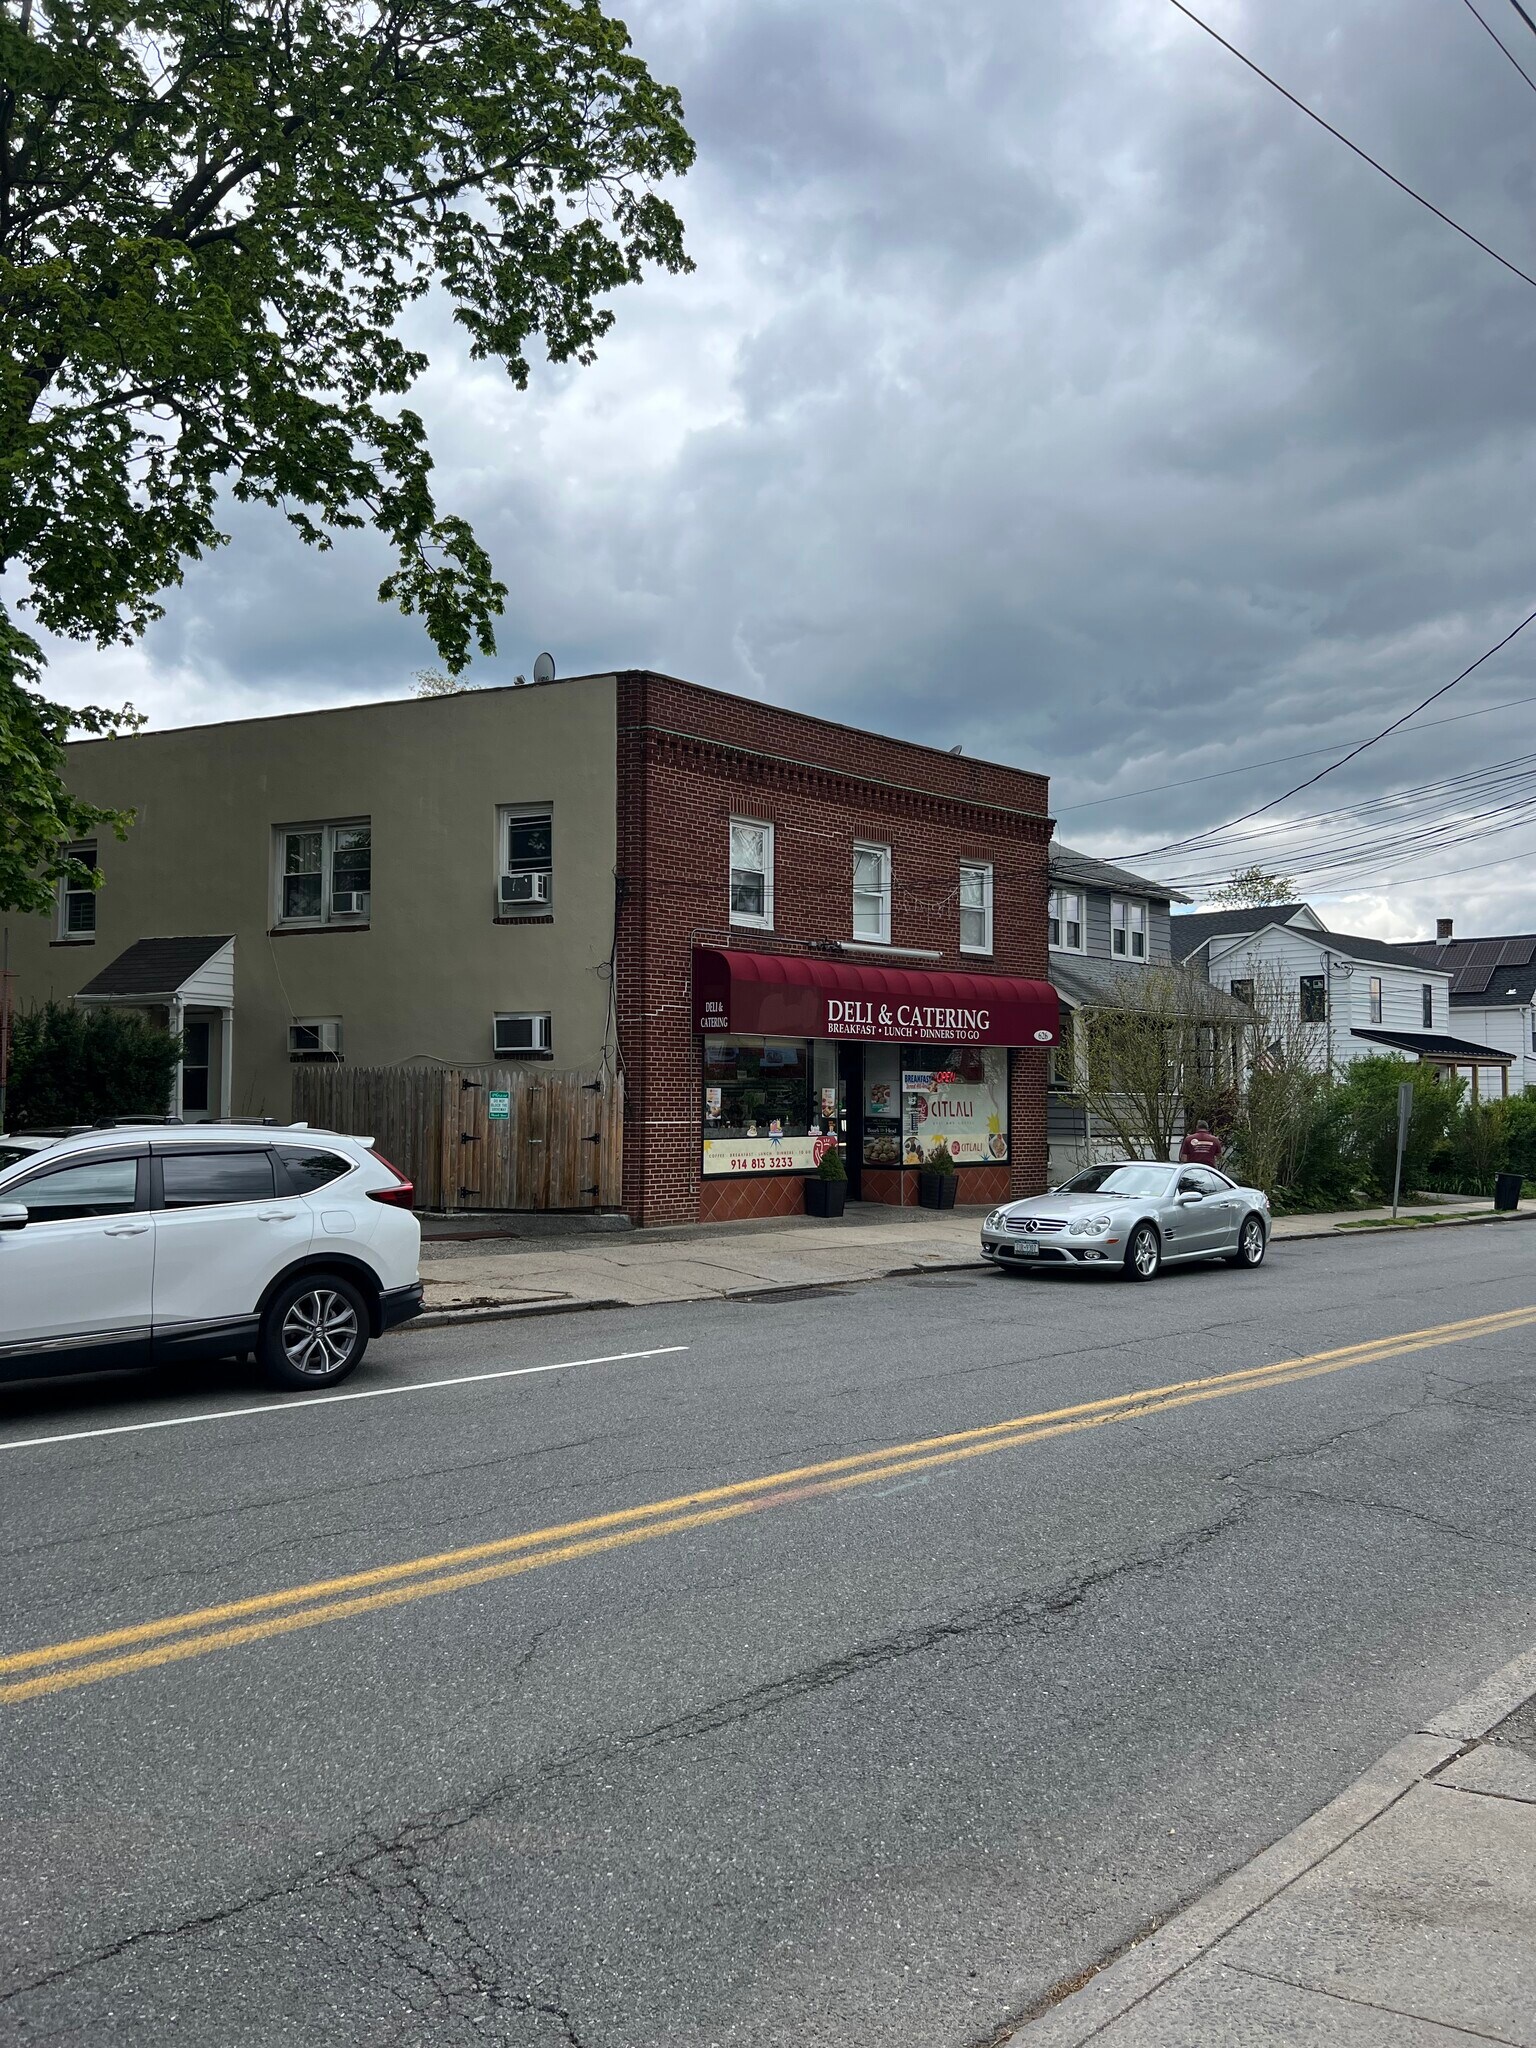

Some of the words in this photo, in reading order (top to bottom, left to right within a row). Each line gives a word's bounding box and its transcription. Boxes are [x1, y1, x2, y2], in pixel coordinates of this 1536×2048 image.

[705, 1001, 718, 1013] DELI
[718, 1001, 724, 1012] &
[828, 1000, 873, 1024] DELI
[878, 1003, 893, 1025] &
[897, 1005, 990, 1030] CATERING
[700, 1016, 728, 1028] CATERING
[828, 1023, 877, 1036] BREAKFAST
[884, 1026, 913, 1038] LUNCH
[920, 1028, 954, 1039] DINNERS
[955, 1030, 966, 1039] TO
[967, 1030, 980, 1040] GO
[936, 1071, 956, 1083] OPEN
[931, 1101, 973, 1117] CITLALI
[961, 1143, 983, 1152] CITLALI
[731, 1159, 747, 1170] 914
[751, 1158, 766, 1169] 813
[770, 1157, 793, 1168] 3233
